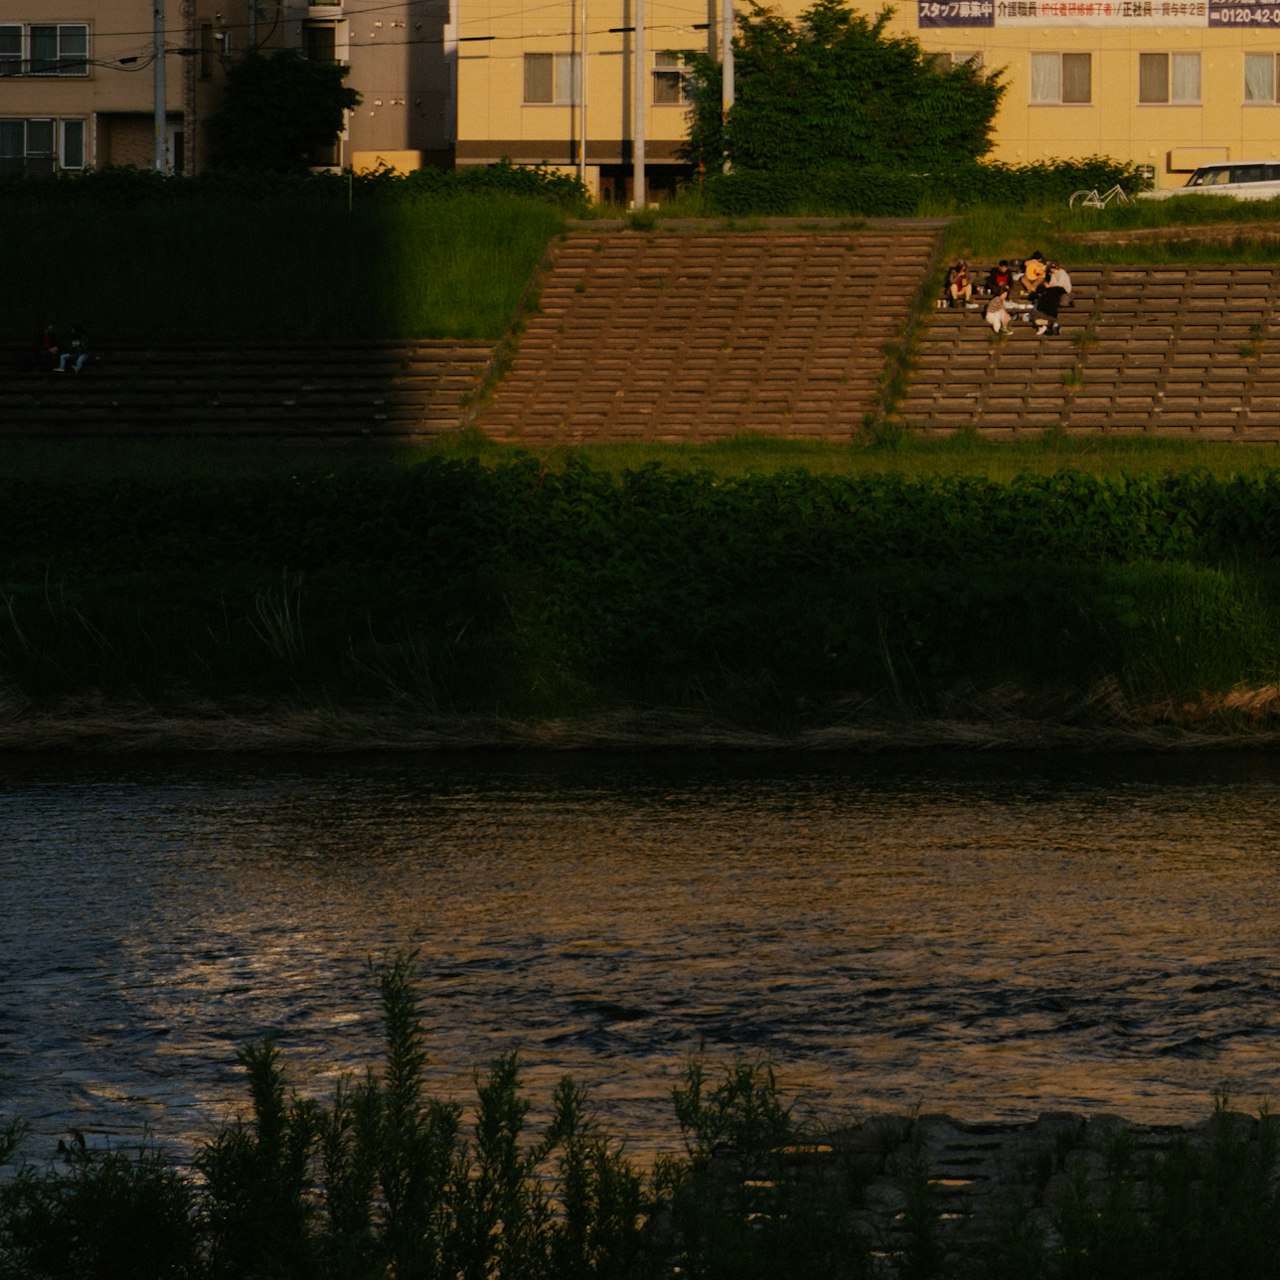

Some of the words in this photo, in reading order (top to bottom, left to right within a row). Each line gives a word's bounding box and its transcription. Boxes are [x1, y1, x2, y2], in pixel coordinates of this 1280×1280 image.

[919, 1, 993, 18] スタッフ募集中
